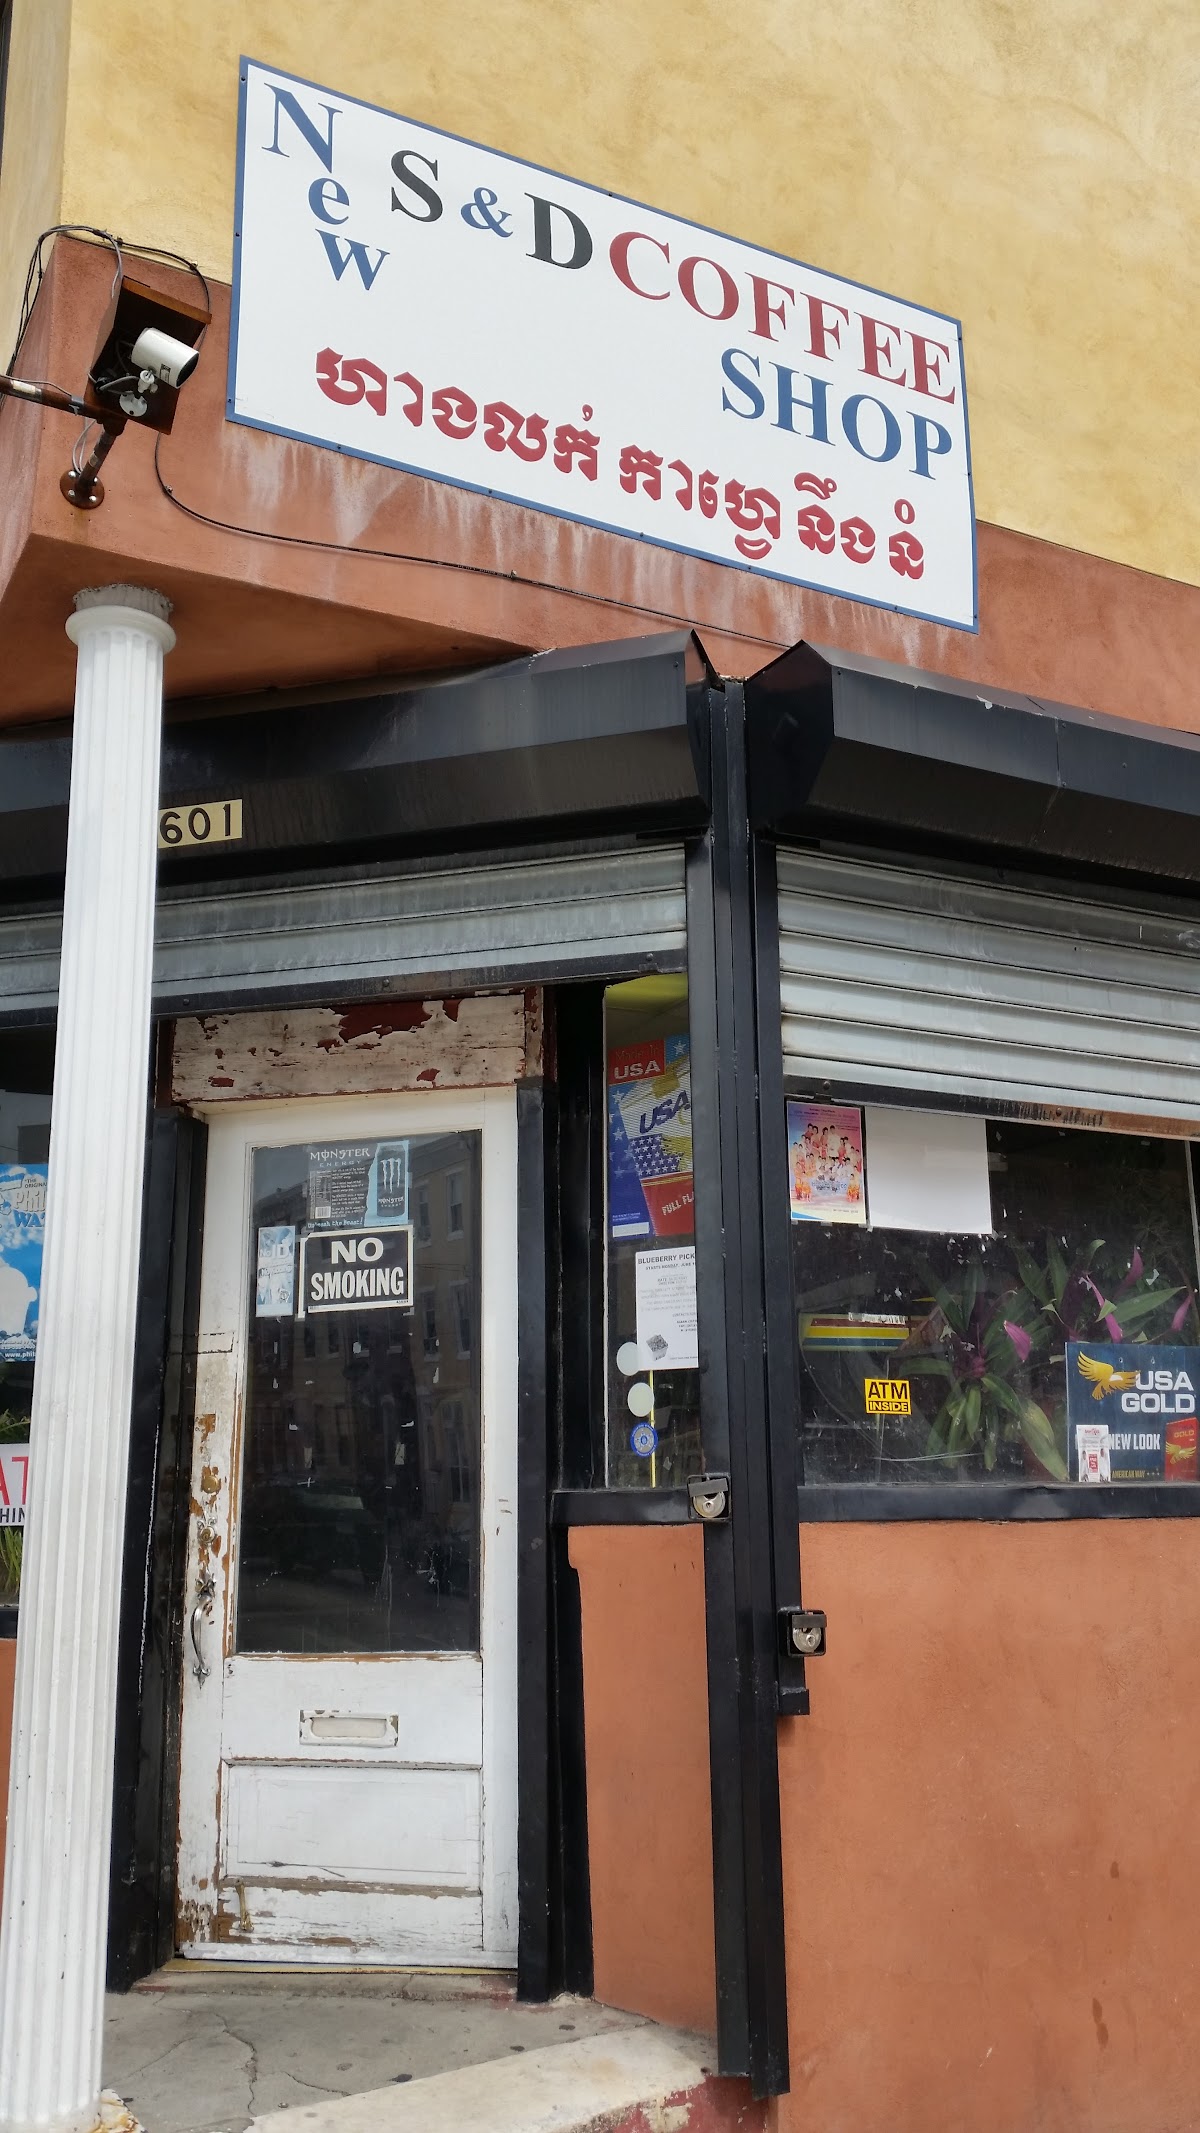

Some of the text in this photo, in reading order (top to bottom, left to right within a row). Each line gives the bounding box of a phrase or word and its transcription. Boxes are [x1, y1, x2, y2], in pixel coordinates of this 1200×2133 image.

[608, 231, 957, 404] COFFEE
[721, 347, 953, 480] SHOP
[160, 803, 231, 845] 601
[614, 1060, 661, 1079] USA
[310, 1147, 371, 1161] MONSTER
[662, 1200, 682, 1216] FULL
[331, 1237, 384, 1264] NO
[638, 1254, 677, 1265] BLUEBERRY
[310, 1266, 404, 1301] SMOKING
[868, 1381, 908, 1400] ATM
[1135, 1370, 1194, 1391] USA
[869, 1401, 908, 1412] INSIDE
[1121, 1392, 1196, 1414] GOLD
[1133, 1433, 1161, 1450] LOOK
